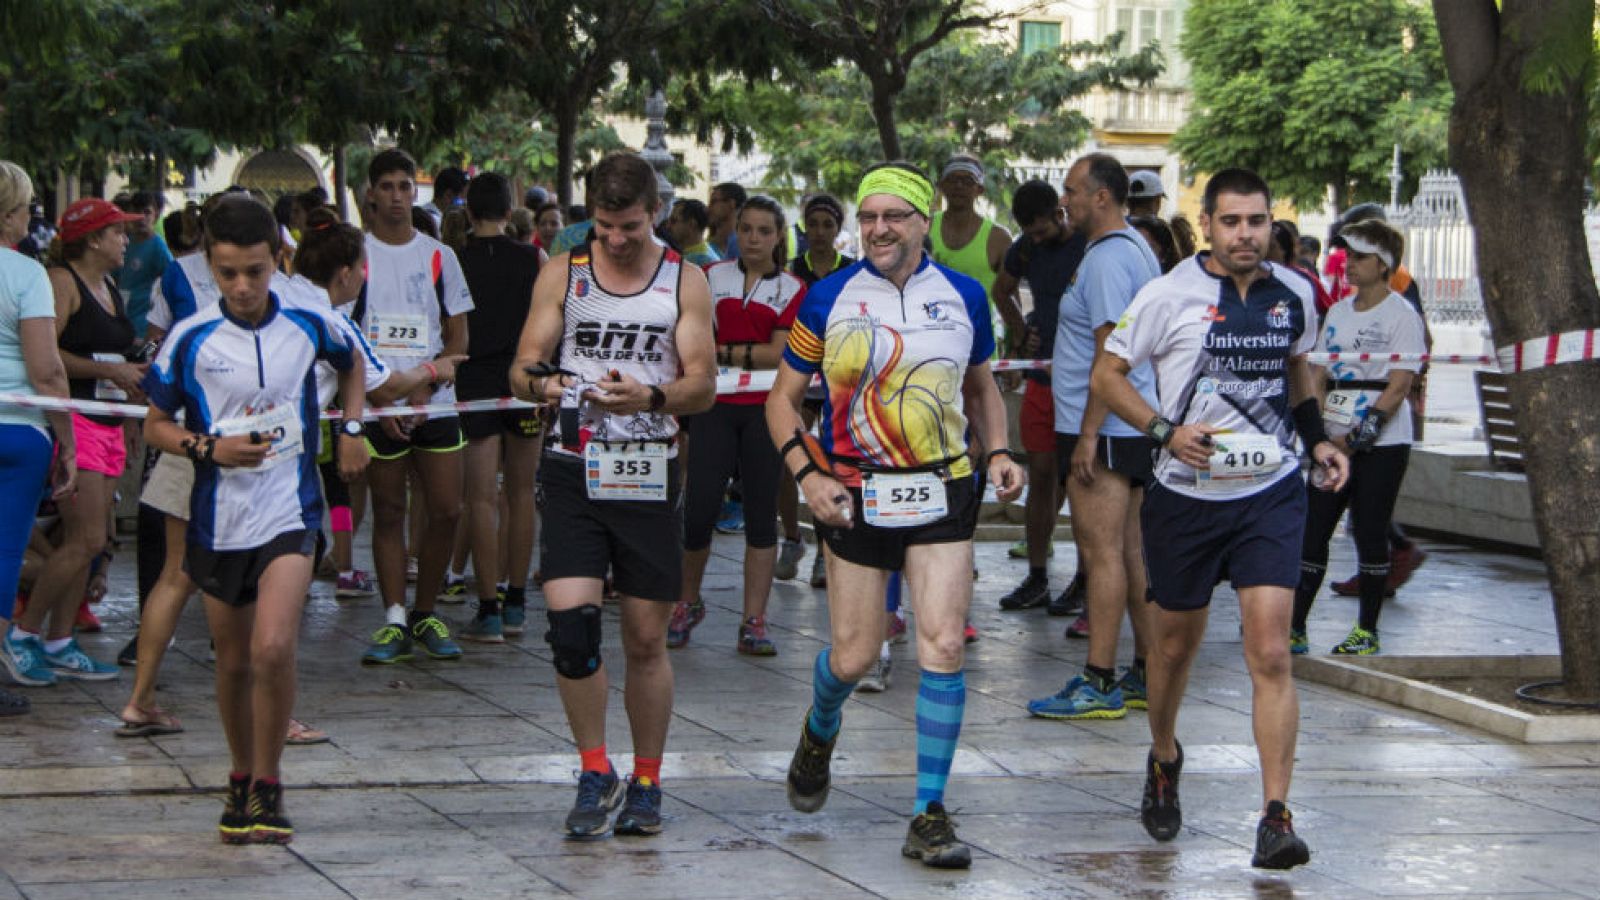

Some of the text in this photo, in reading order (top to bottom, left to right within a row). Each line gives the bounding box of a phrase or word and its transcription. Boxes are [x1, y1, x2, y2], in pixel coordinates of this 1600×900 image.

[388, 326, 418, 339] 273
[613, 350, 633, 360] DE
[637, 352, 663, 362] VES
[1224, 451, 1265, 467] 410
[613, 460, 651, 475] 353
[890, 487, 930, 503] 525
